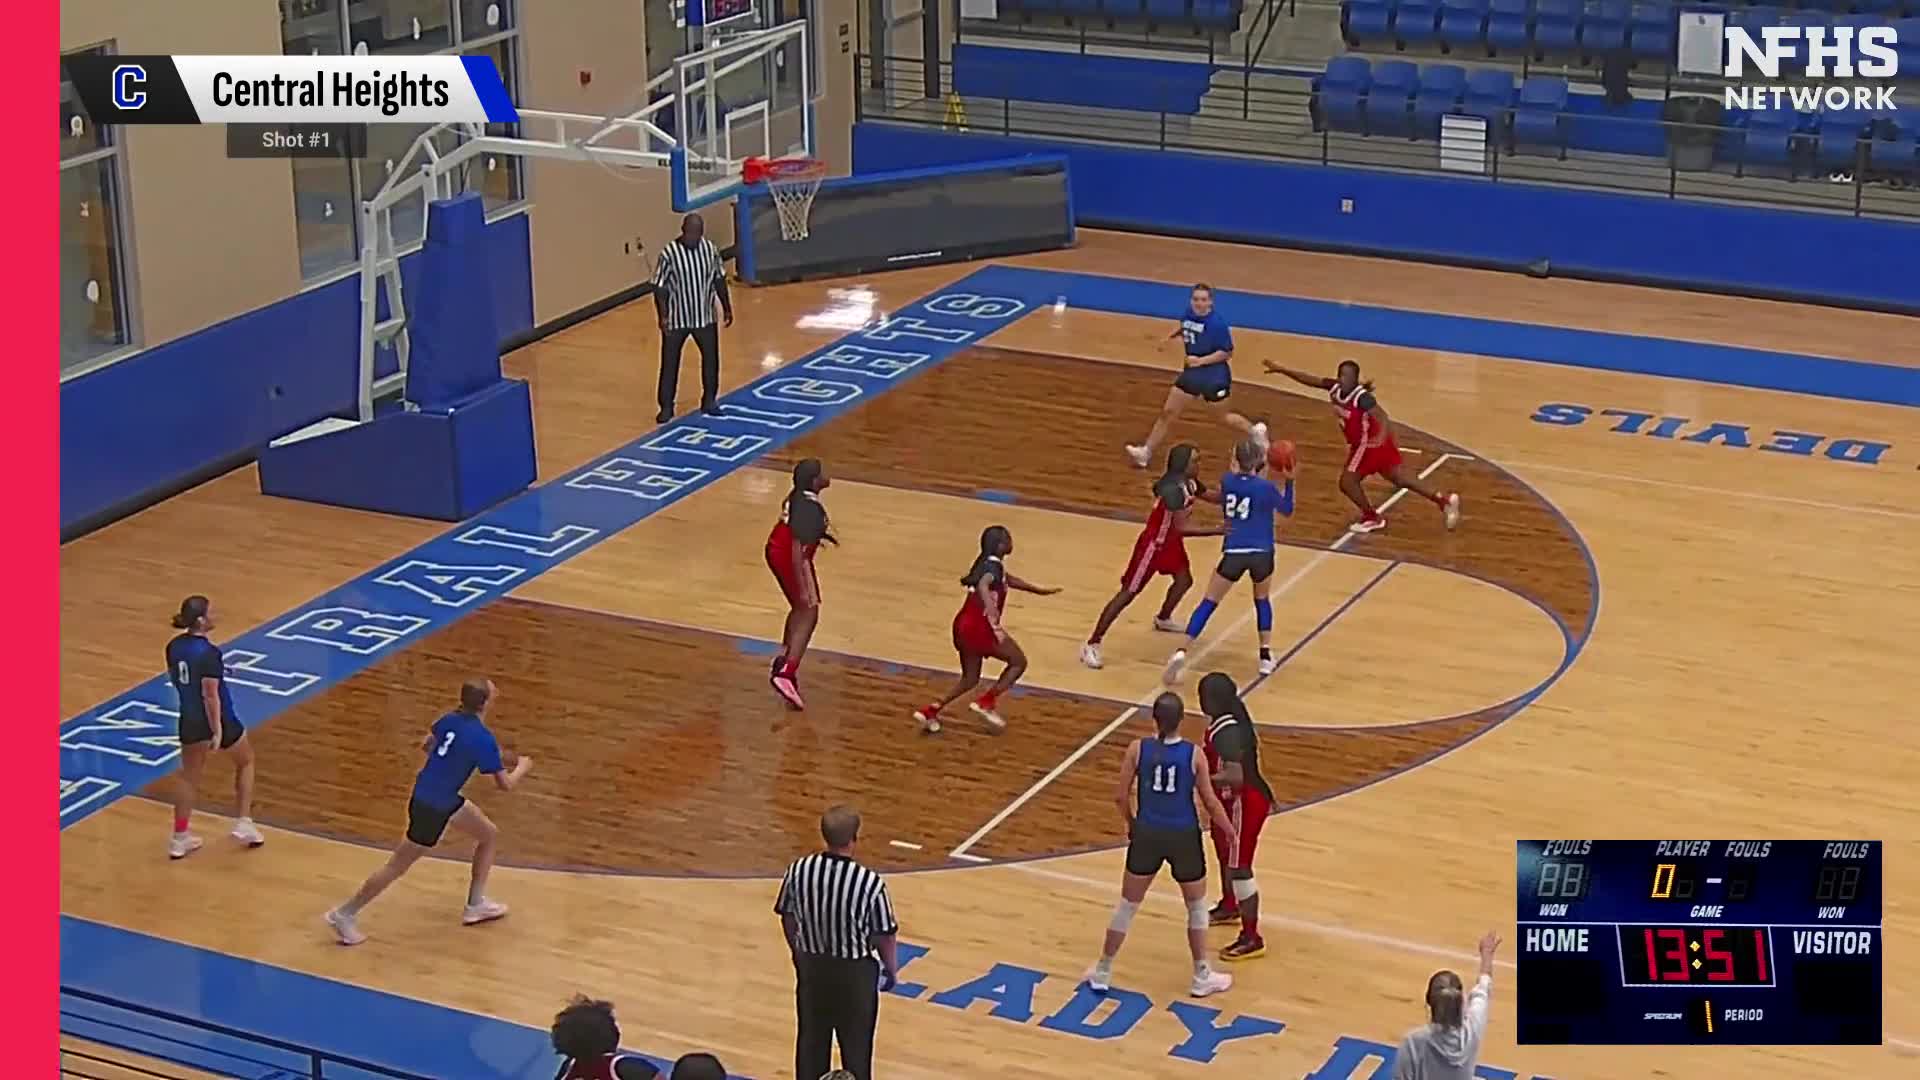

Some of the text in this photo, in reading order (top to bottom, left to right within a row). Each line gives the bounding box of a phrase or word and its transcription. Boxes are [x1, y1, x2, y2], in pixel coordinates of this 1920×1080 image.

[565, 294, 1026, 500] HEIGHTS
[1530, 403, 1892, 465] DEVILS
[1226, 493, 1251, 520] 24
[178, 661, 190, 685] 0
[438, 731, 456, 757] 3
[1153, 765, 1176, 792] 11
[1542, 840, 1592, 856] FOULS
[1656, 841, 1772, 858] PLAYER FOULS
[1823, 842, 1869, 859] FOULS
[1539, 904, 1569, 917] WON
[1690, 905, 1724, 918] GAME
[1817, 906, 1846, 919] WON
[1526, 928, 1589, 952] HOME
[1793, 930, 1871, 955] VISITOR
[1644, 928, 1767, 981] 13:51
[1725, 1008, 1763, 1021] PERIOD
